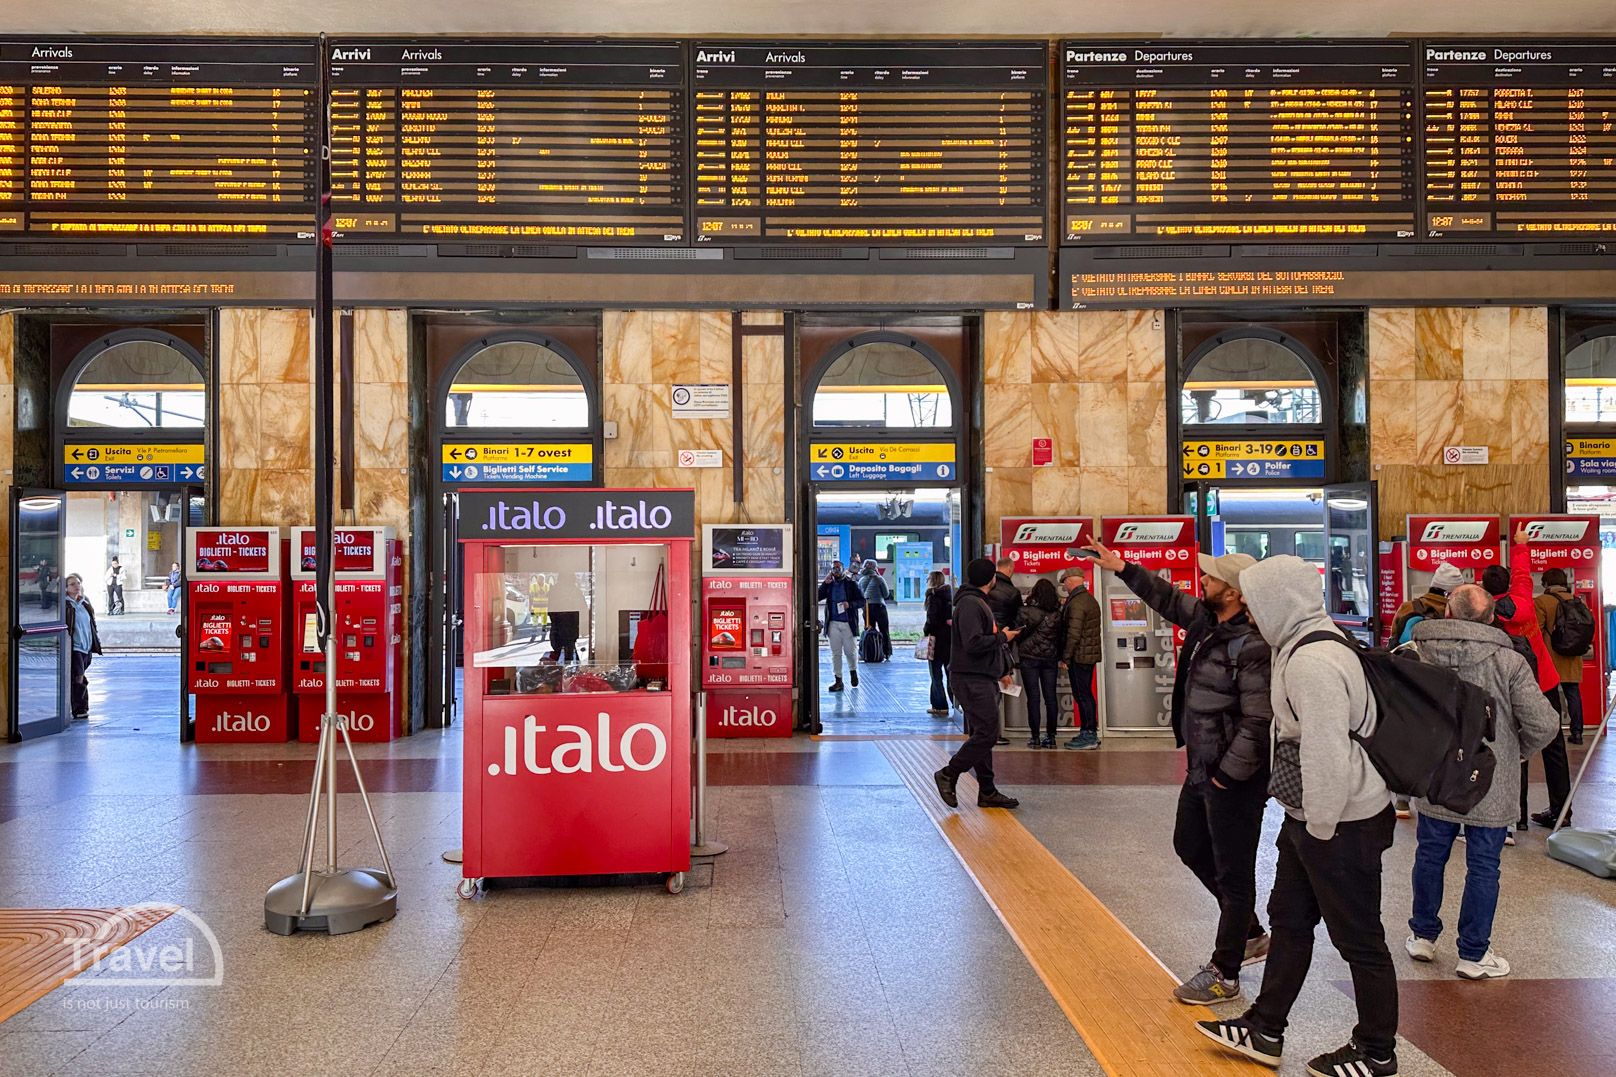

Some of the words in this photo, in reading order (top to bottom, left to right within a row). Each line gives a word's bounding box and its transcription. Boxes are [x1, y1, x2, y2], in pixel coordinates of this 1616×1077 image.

[31, 46, 73, 58] Arrivals
[331, 48, 371, 60] Arrivi
[401, 48, 442, 60] Arrivals
[696, 50, 735, 63] Arrivi
[765, 51, 806, 63] Arrivals
[1066, 50, 1127, 62] Partenze
[1134, 50, 1193, 63] Departures
[1426, 49, 1487, 60] Partenze
[1494, 48, 1552, 62] Departures
[1215, 444, 1241, 452] Binari
[1245, 444, 1273, 454] 3-19
[1579, 441, 1611, 449] Binario
[105, 447, 132, 455] Uscita
[483, 447, 509, 455] Binari
[514, 447, 534, 457] 1-7
[538, 448, 572, 457] ovest
[1265, 462, 1291, 470] Polfer
[1580, 459, 1599, 468] Sala
[105, 466, 135, 474] Servizi
[483, 465, 517, 474] Biglietti
[849, 464, 887, 473] Deposito
[888, 464, 922, 474] Bagagli
[1580, 467, 1601, 475] Waiting
[862, 472, 887, 480] Luggage
[199, 547, 232, 557] BIGLIETTI
[239, 547, 266, 557] TICKETS
[343, 546, 371, 556] TICKETS
[1023, 550, 1061, 560] Biglietti
[1124, 550, 1162, 559] Biglietti
[1430, 549, 1468, 558] Biglietti
[1531, 549, 1567, 558] Biglietti
[739, 581, 762, 589] BIGLIETTI
[767, 581, 788, 589] TICKETS
[739, 674, 762, 682] BIGLIETTI
[767, 674, 788, 682] TICKETS
[227, 680, 250, 688] BIGLIETTI
[255, 679, 276, 687] TICKETS
[359, 679, 380, 687] TICKETS
